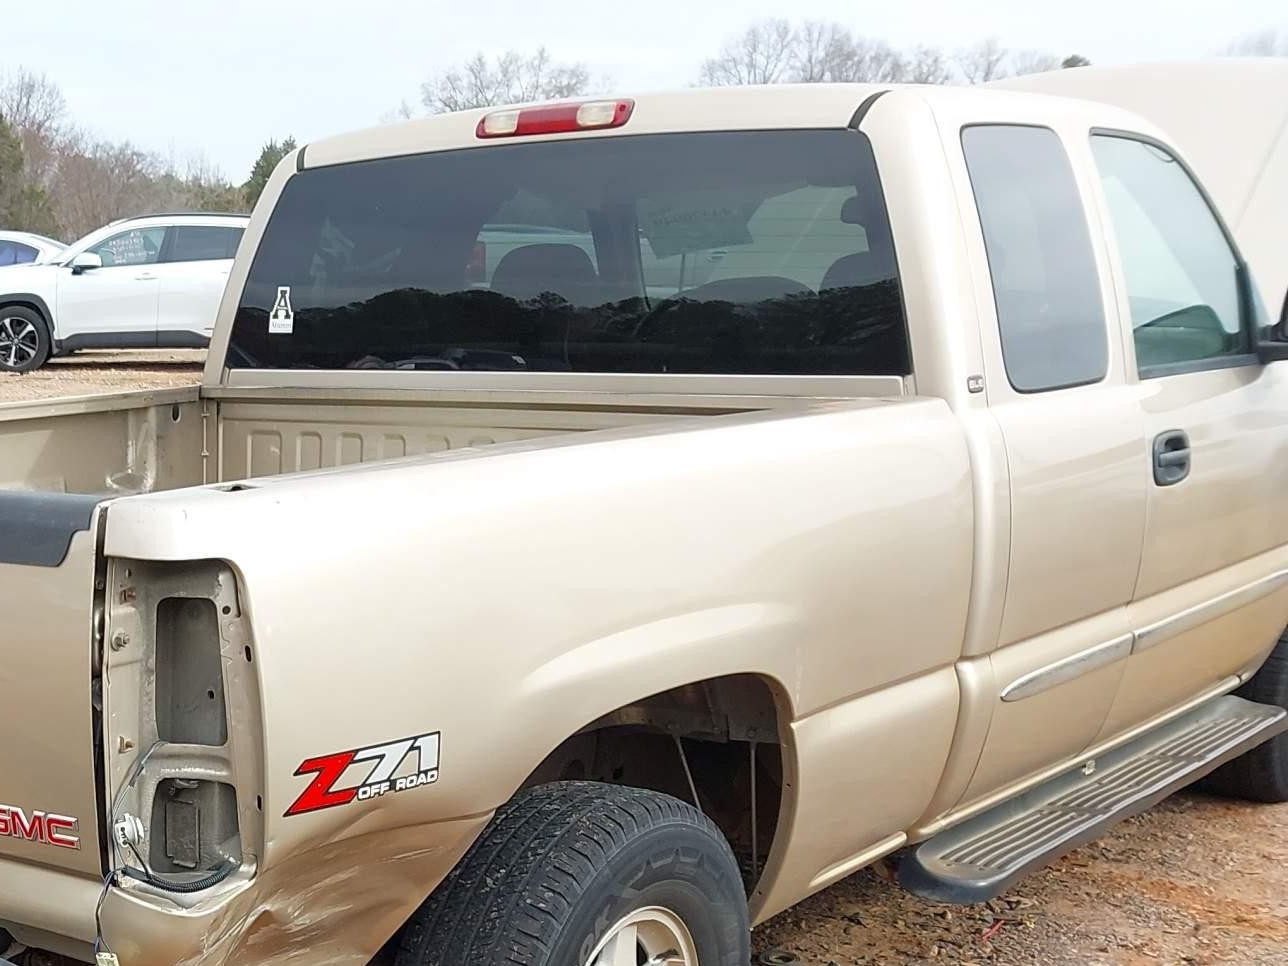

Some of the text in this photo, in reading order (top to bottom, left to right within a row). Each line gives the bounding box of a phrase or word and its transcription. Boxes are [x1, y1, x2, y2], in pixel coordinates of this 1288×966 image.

[272, 289, 291, 319] A
[283, 731, 441, 818] Z71
[357, 770, 438, 800] OFF ROAD
